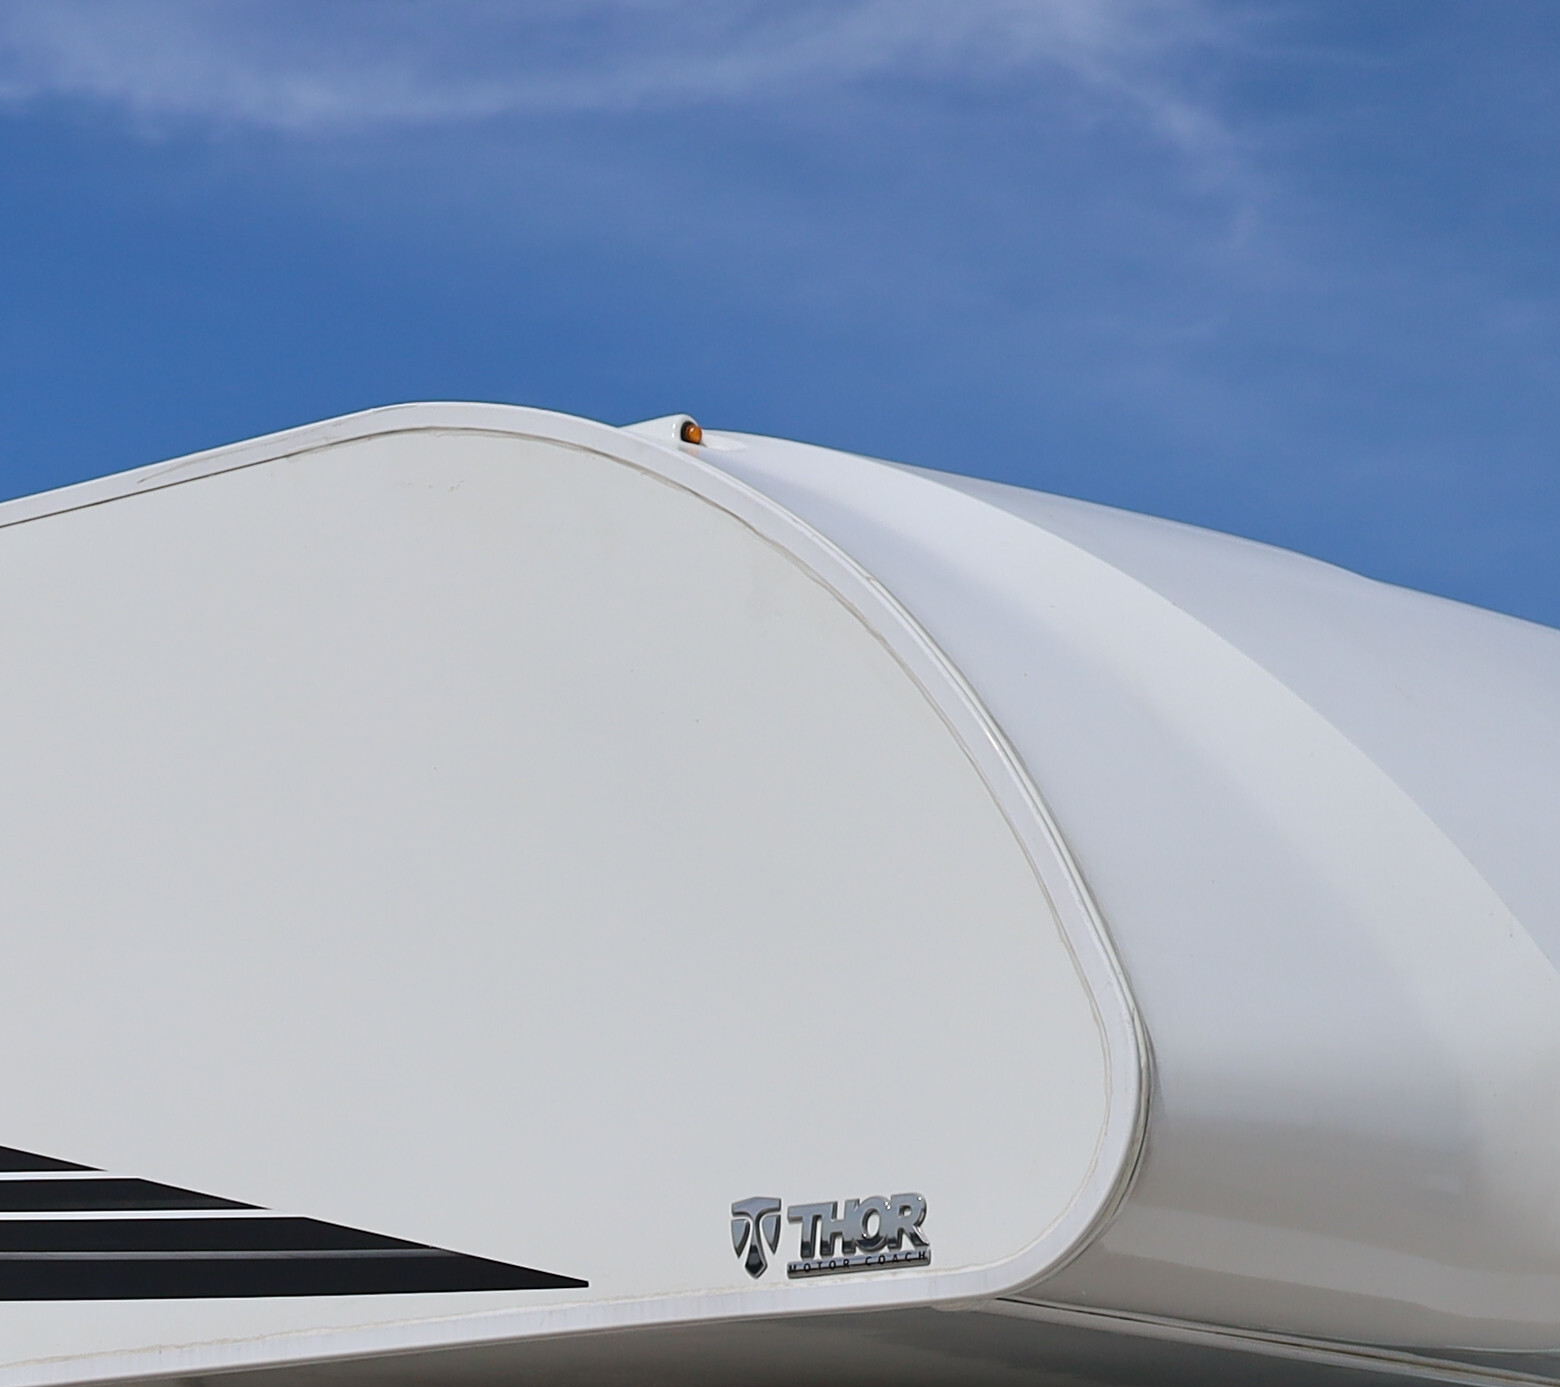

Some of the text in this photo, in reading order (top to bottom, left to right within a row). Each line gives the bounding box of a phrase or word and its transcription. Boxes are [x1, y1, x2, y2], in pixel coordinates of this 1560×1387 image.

[787, 1192, 929, 1259] THOR
[788, 1250, 927, 1273] MOTOR COACH
